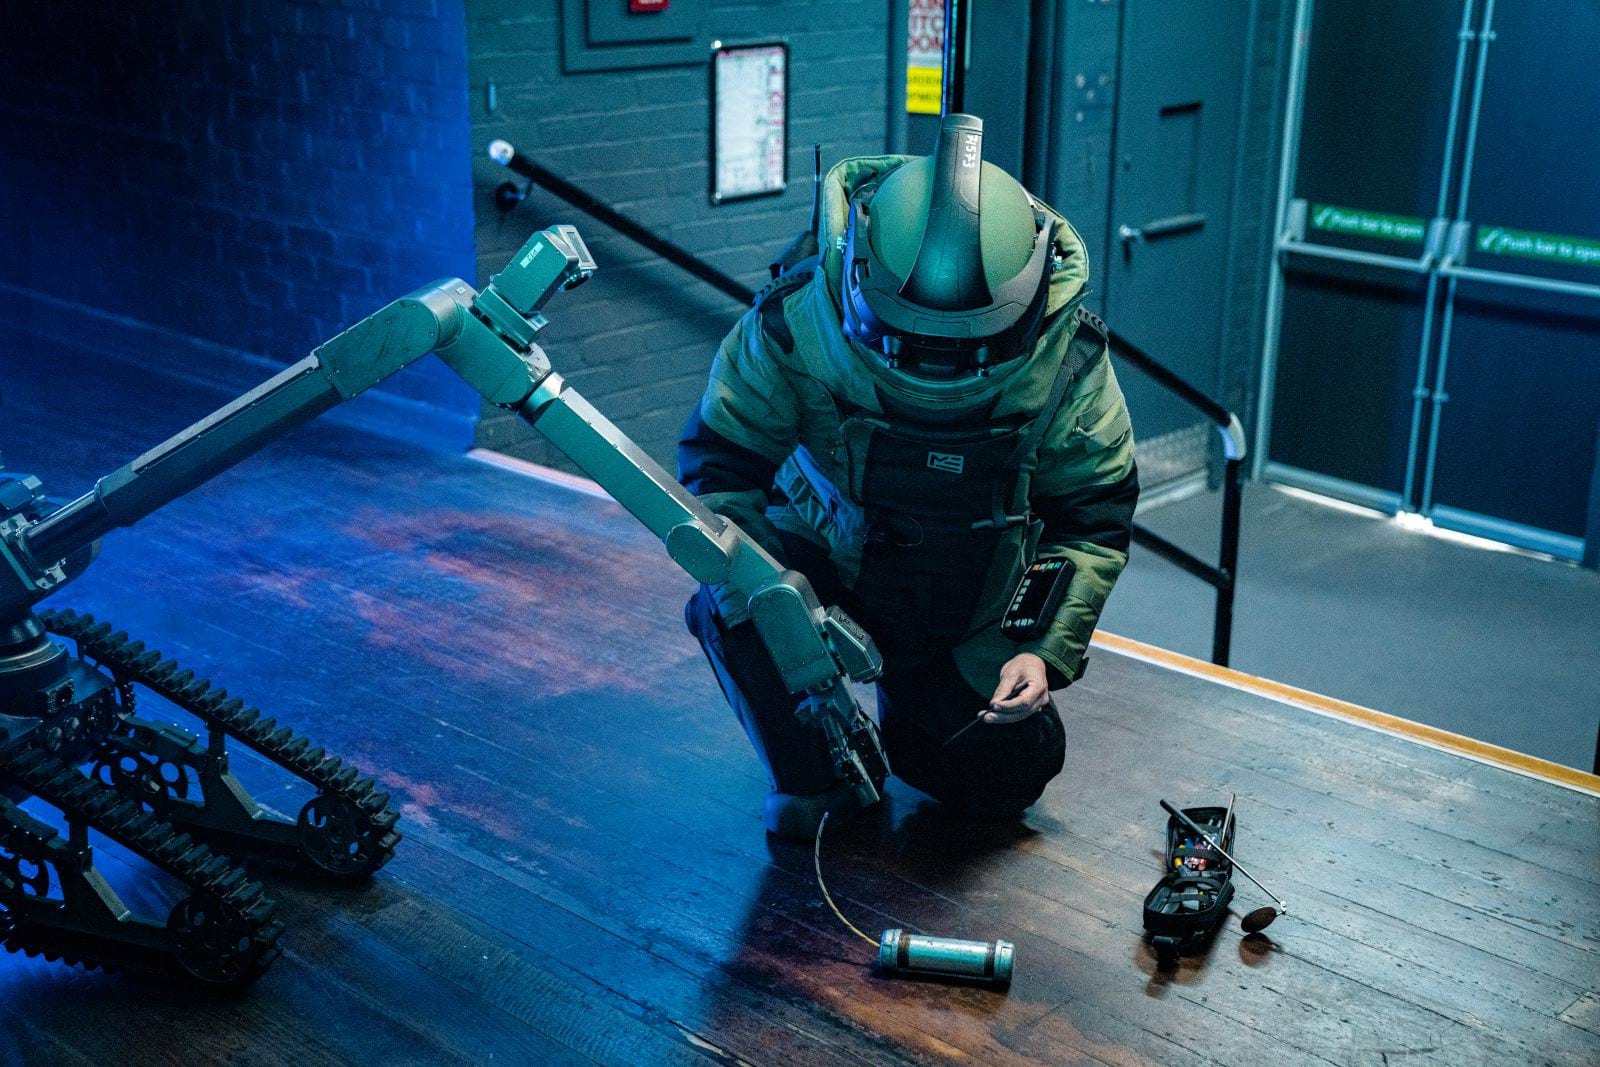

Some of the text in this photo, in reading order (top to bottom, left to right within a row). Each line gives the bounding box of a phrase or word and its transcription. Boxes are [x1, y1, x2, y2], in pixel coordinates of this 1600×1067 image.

[1329, 210, 1425, 239] Push bar to open
[1495, 233, 1600, 263] Push bar to ope
